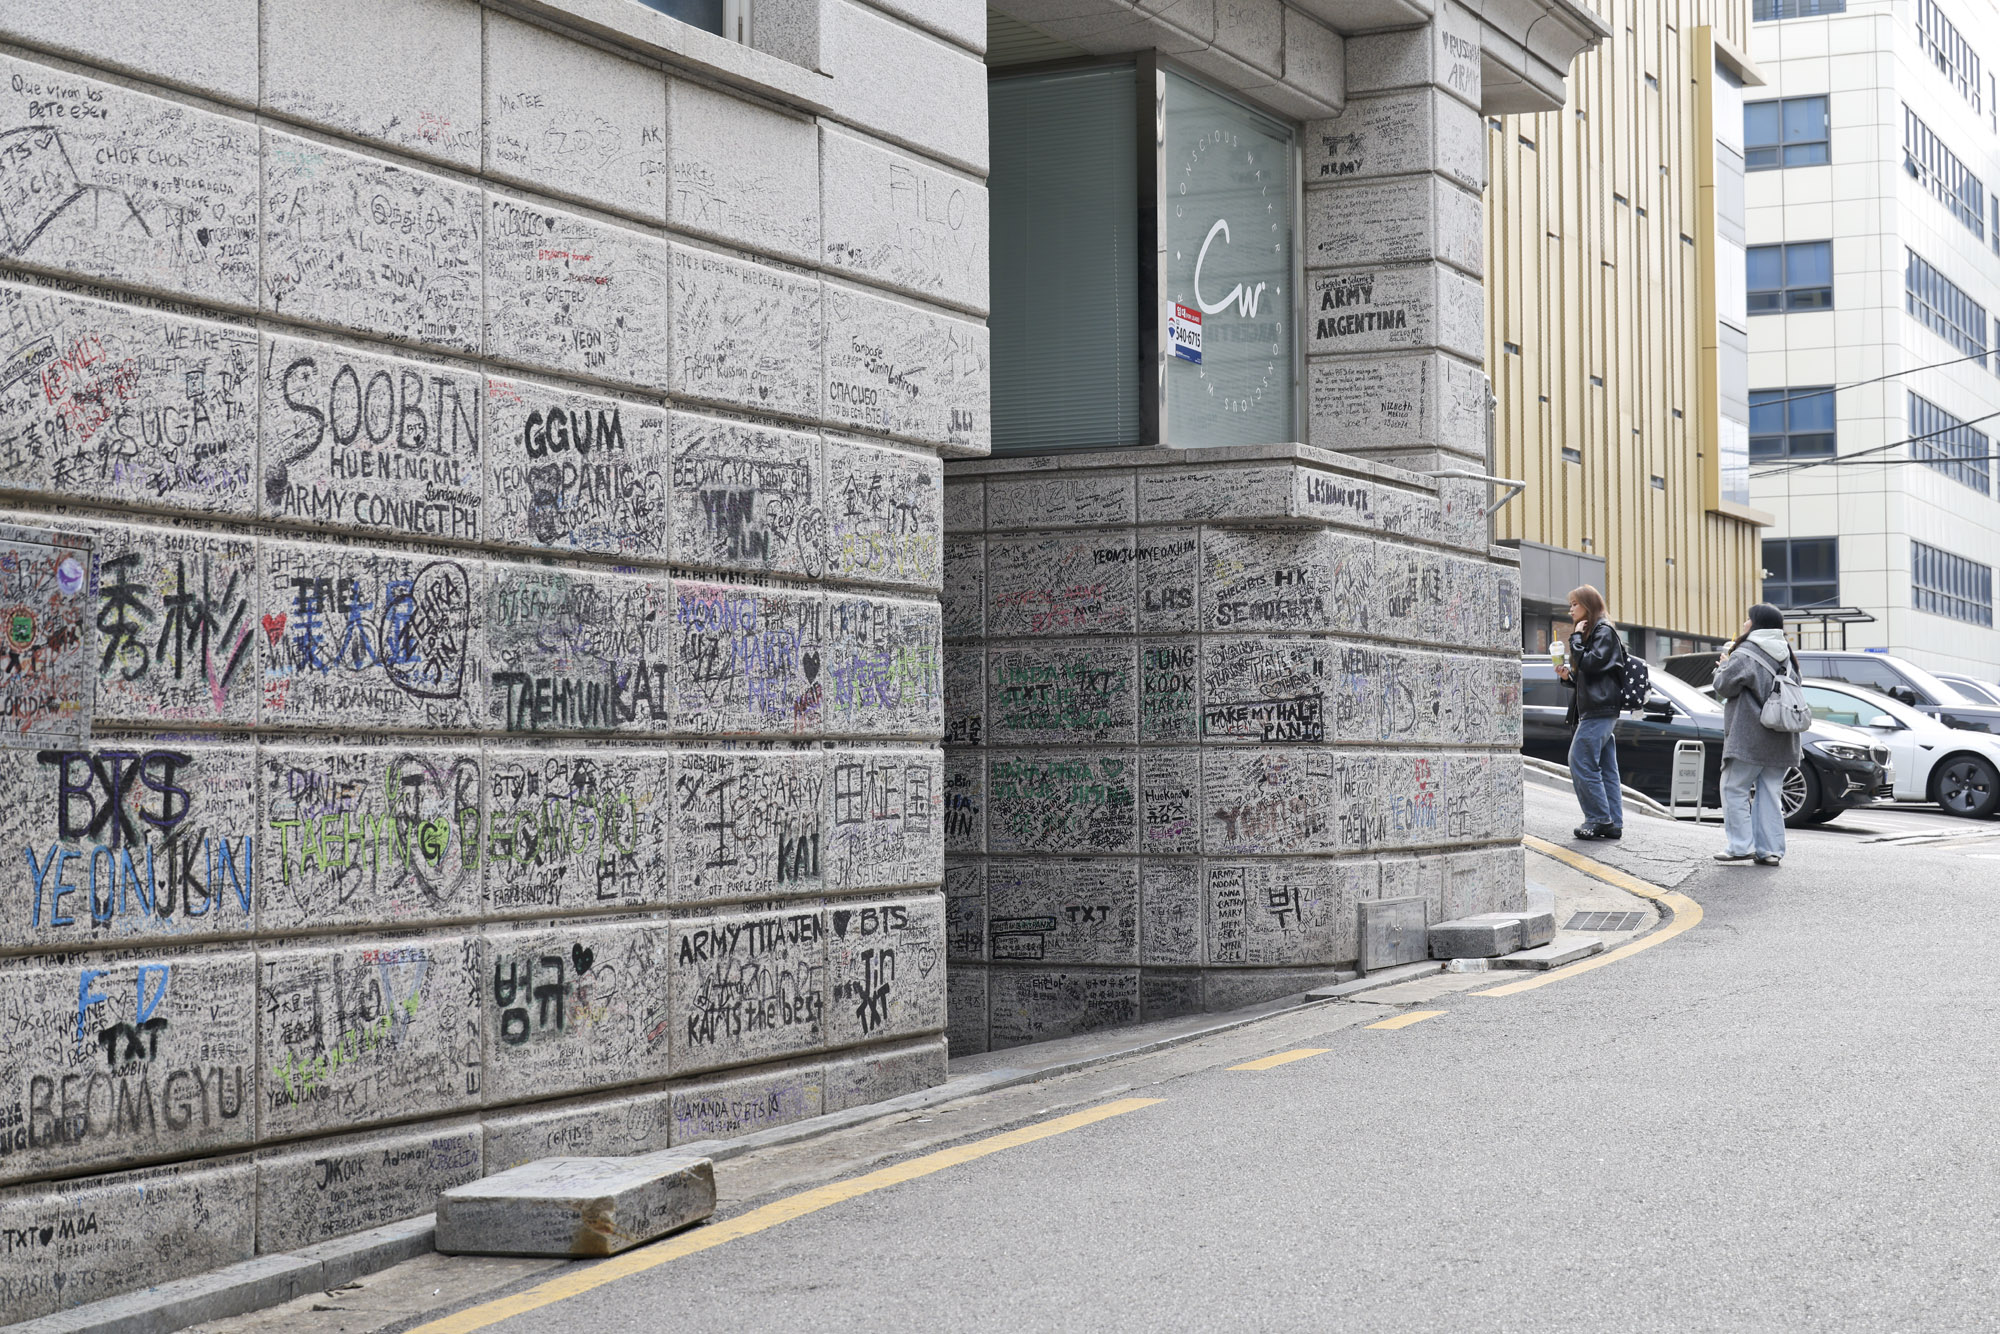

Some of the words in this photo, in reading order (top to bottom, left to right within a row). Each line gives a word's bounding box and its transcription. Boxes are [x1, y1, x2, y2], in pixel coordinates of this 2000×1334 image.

[12, 74, 41, 96] Que
[47, 85, 81, 99] vivan
[1320, 158, 1364, 176] ARMY
[173, 176, 234, 195] NICARAGUA
[493, 200, 546, 239] MEXICO
[35, 275, 52, 287] YOU
[55, 279, 83, 295] RIGHT
[87, 285, 120, 300] SEVEN
[122, 291, 144, 306] DAYS
[1321, 286, 1373, 311] ARMY
[165, 325, 187, 349] WE
[191, 330, 220, 351] ARE
[572, 328, 602, 351] YEON
[1176, 326, 1200, 348] 540-6715
[1316, 309, 1407, 340] ARGENTINA
[584, 351, 607, 369] JUN
[830, 381, 877, 406] СПАСИБО
[283, 356, 480, 468] SOOBIN
[115, 398, 214, 457] SUGA
[524, 406, 625, 459] GGUM
[284, 484, 347, 520] ARMY
[353, 492, 450, 534] CONNECT
[452, 503, 477, 539] PH
[728, 571, 747, 585] BTS
[752, 573, 769, 588] SEE
[780, 579, 789, 590] IN
[790, 580, 809, 591] 2025
[678, 596, 758, 631] YOONGI
[731, 626, 806, 678] MARRY
[610, 659, 669, 725] KAI
[1145, 674, 1194, 694] KOOK
[1206, 706, 1248, 727] TAKE
[1251, 706, 1275, 722] MY
[1277, 698, 1318, 722] HALF
[1264, 721, 1323, 742] PANIC
[60, 751, 190, 848] BTS
[774, 771, 824, 811] ARMY
[777, 832, 821, 884] KAI
[25, 835, 252, 929] YEONJUN
[727, 881, 755, 895] PURPLE
[754, 879, 773, 893] CAFE
[1211, 869, 1236, 880] ARMY
[1212, 879, 1240, 889] NOONA
[1217, 890, 1241, 899] ANNA
[860, 906, 909, 937] BTS
[1065, 905, 1110, 923] TXT
[1218, 908, 1242, 919] MARY
[680, 923, 742, 967] ARMY
[788, 909, 825, 944] JEN
[35, 954, 58, 967] TIA
[68, 951, 90, 966] BTS
[745, 1000, 776, 1033] the
[779, 987, 824, 1027] best
[856, 982, 892, 1035] TXT
[100, 1016, 169, 1066] TXT
[30, 1065, 243, 1145] BEOMGYU
[685, 1102, 729, 1120] AMANDA
[744, 1102, 766, 1120] BTS
[3, 1226, 38, 1253] TXT
[58, 1212, 98, 1240] MOA
